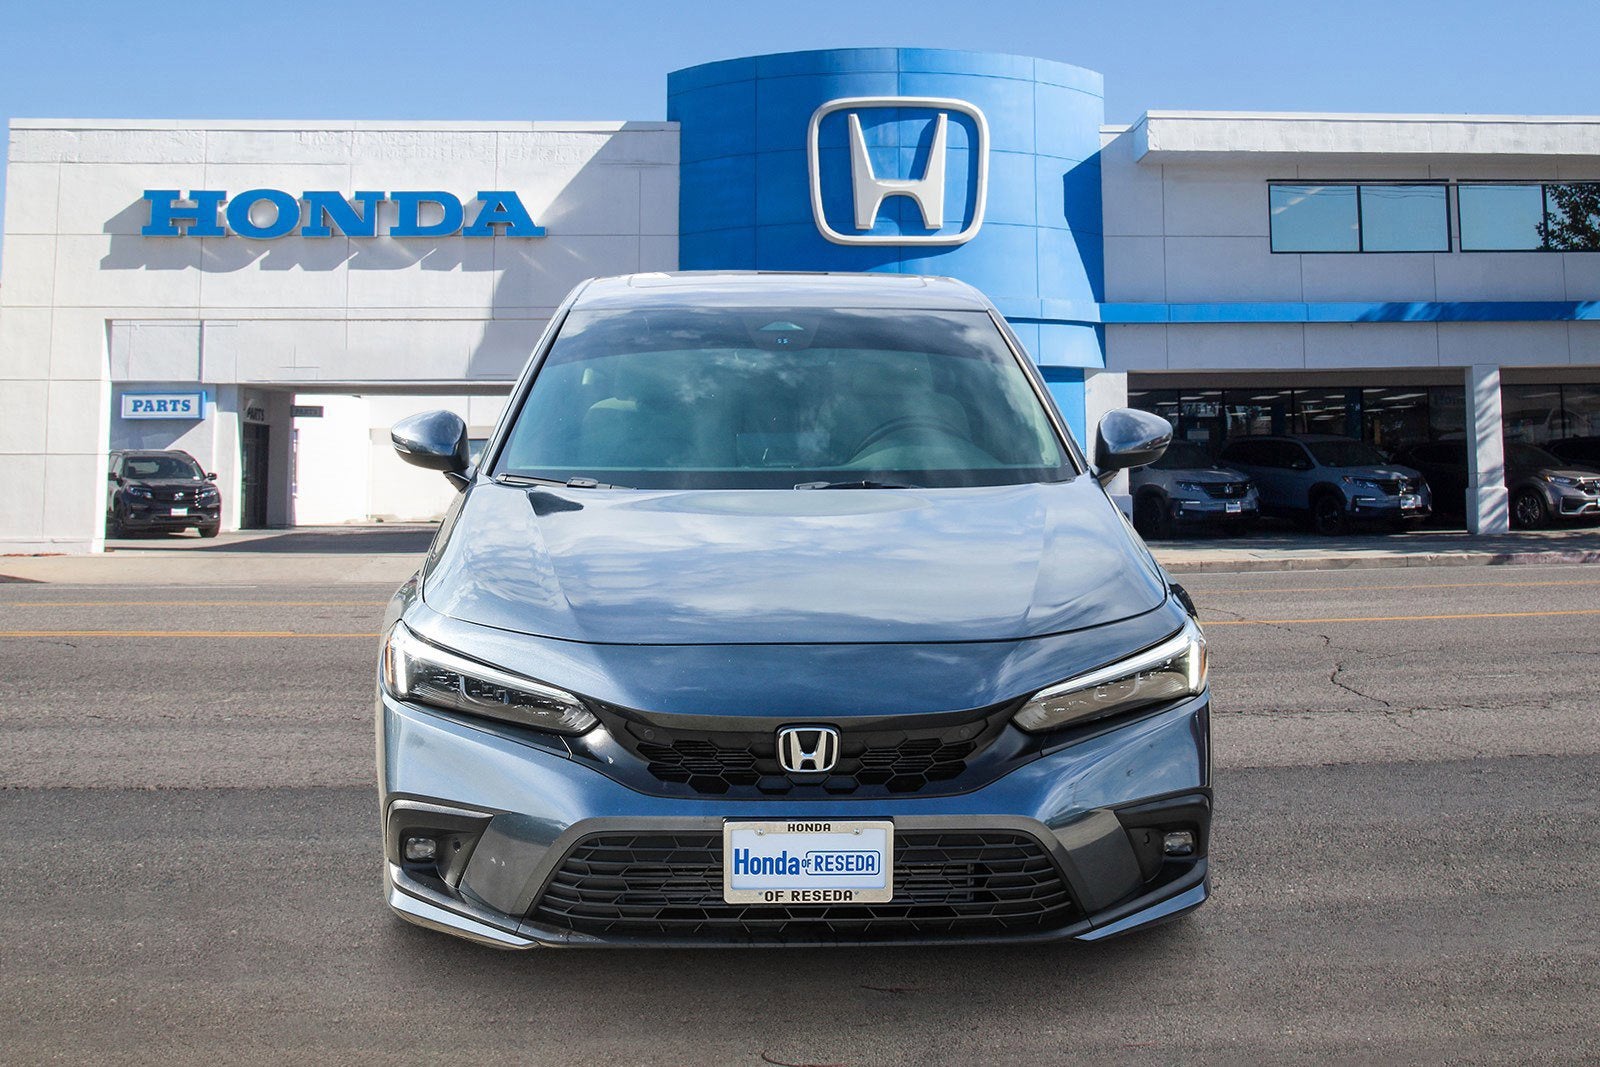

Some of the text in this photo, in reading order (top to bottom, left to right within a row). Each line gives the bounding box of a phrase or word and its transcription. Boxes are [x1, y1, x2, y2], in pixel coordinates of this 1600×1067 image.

[141, 189, 547, 239] HONDA
[132, 399, 191, 412] PARTS
[787, 823, 832, 832] HONDA
[734, 848, 875, 875] Honda OF RESEDA
[764, 890, 853, 902] OF RESEDA
